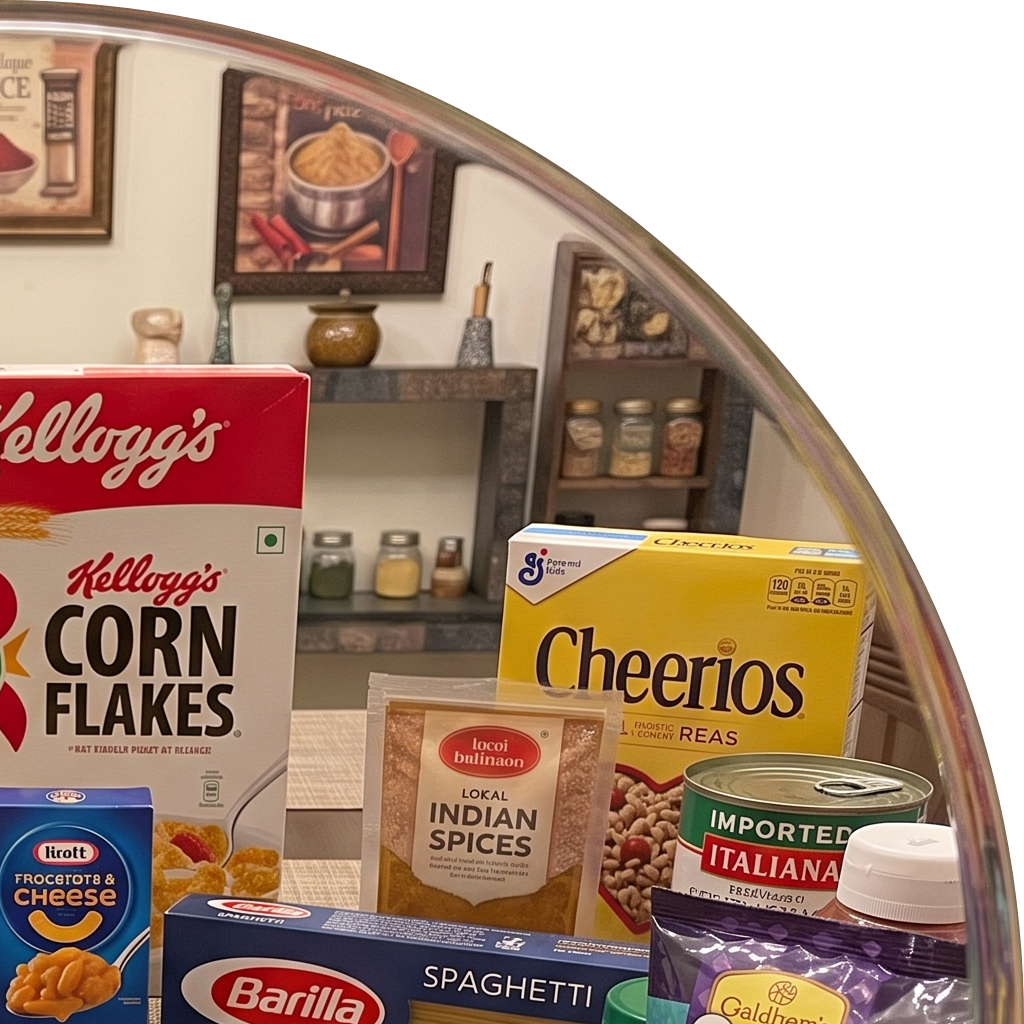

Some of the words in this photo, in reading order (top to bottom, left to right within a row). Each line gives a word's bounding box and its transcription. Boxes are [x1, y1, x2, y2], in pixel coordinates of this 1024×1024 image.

[66, 552, 223, 607] Kellogg's
[772, 579, 789, 591] 120
[44, 604, 238, 678] CORN
[536, 626, 805, 719] Cheerios
[45, 683, 235, 738] FLAKES
[679, 726, 738, 746] REAS
[462, 788, 508, 801] LOKAL
[429, 802, 538, 831] INDIAN
[709, 809, 852, 846] IMPORTED
[429, 829, 532, 857] SPICES
[422, 965, 593, 1009] SPAGHETTI
